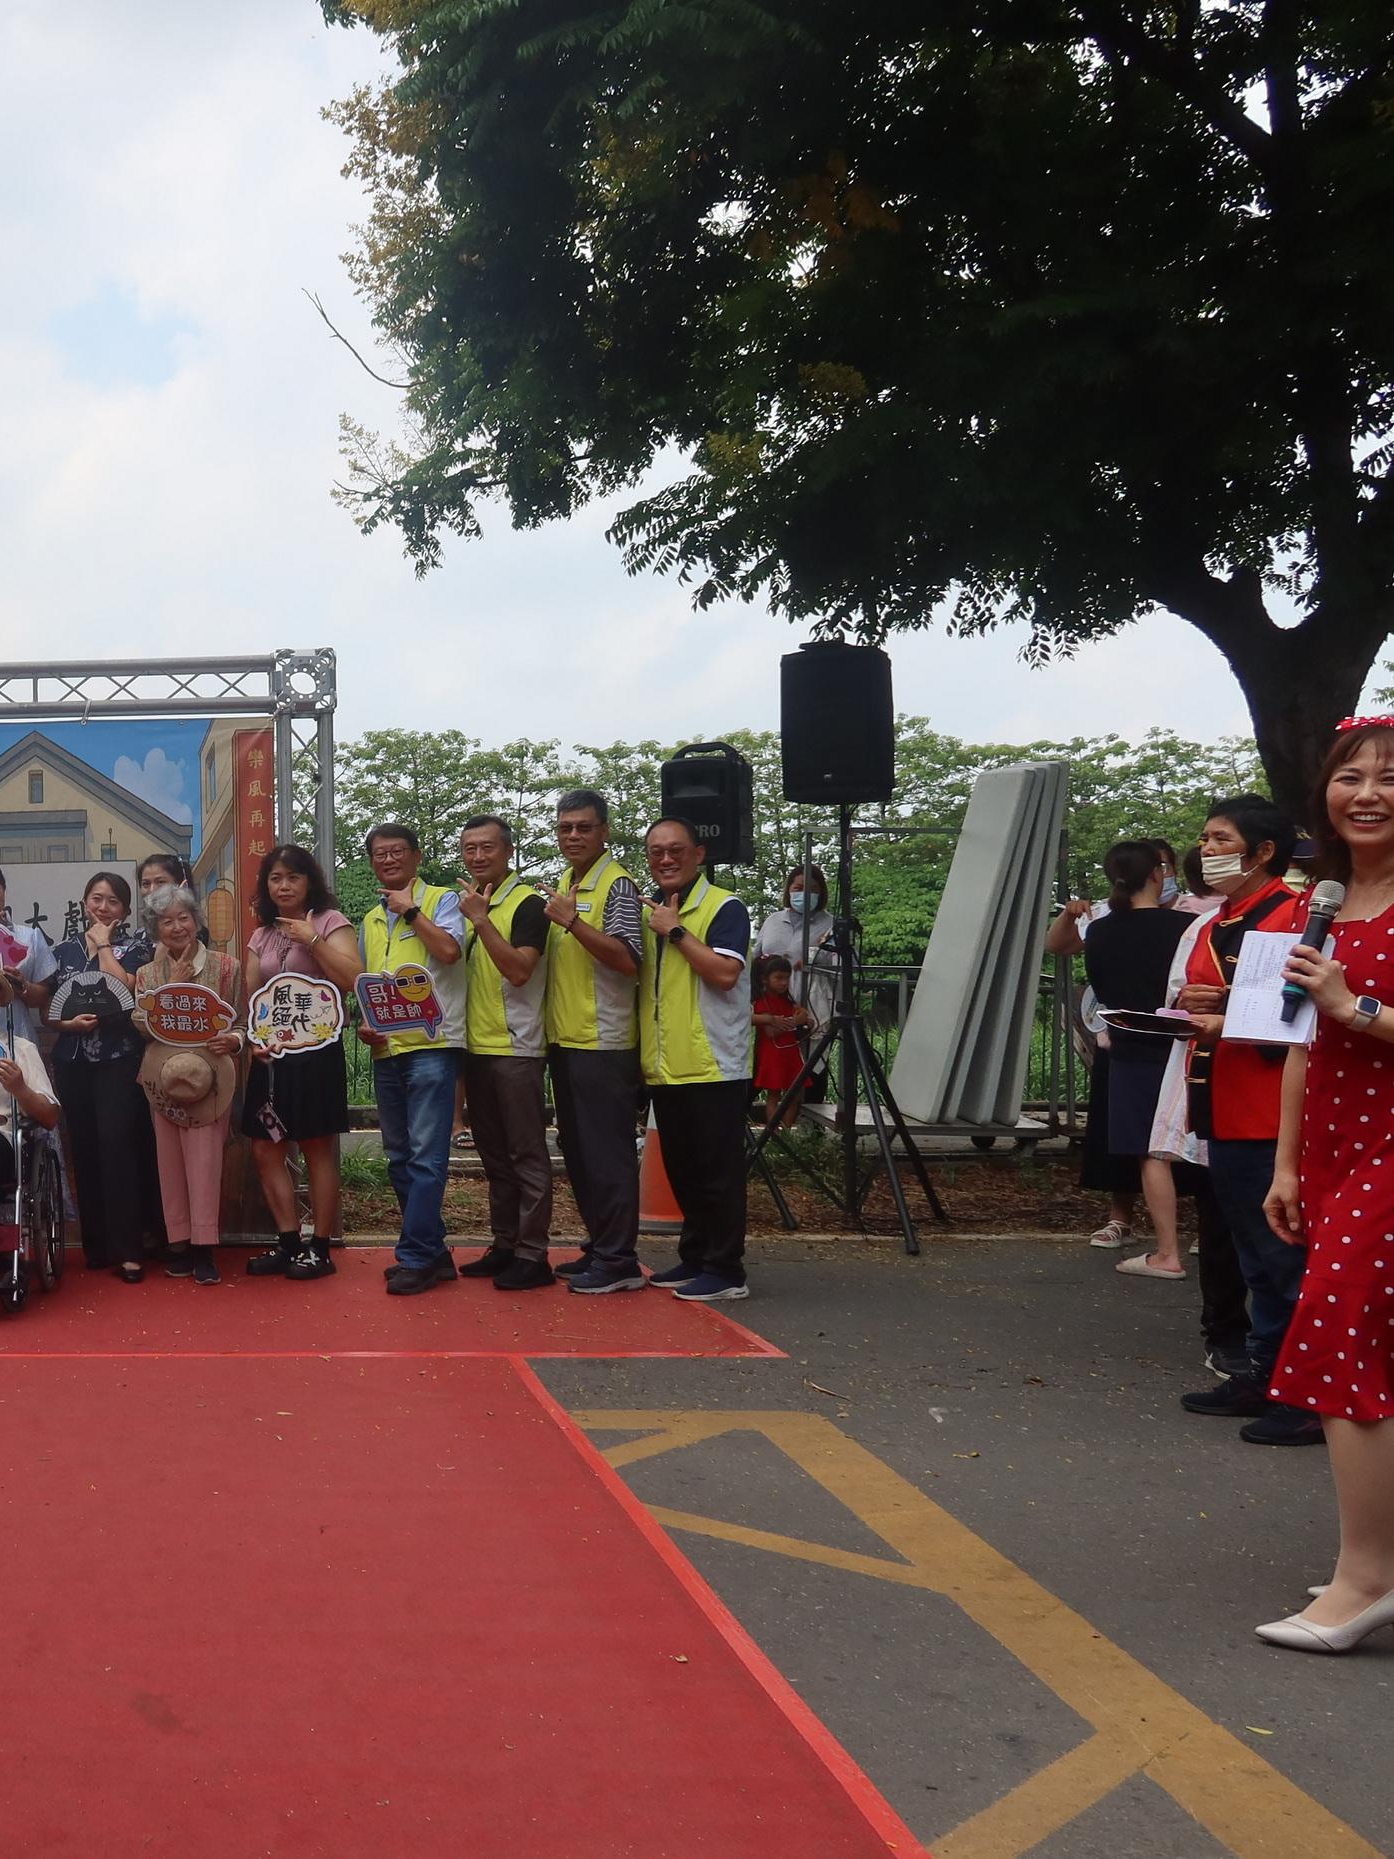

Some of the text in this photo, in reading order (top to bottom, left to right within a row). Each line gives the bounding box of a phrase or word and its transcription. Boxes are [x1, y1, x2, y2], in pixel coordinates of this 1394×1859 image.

[159, 993, 207, 1012] 看過來
[375, 1004, 423, 1020] 就是帥
[161, 1014, 209, 1032] 我最水
